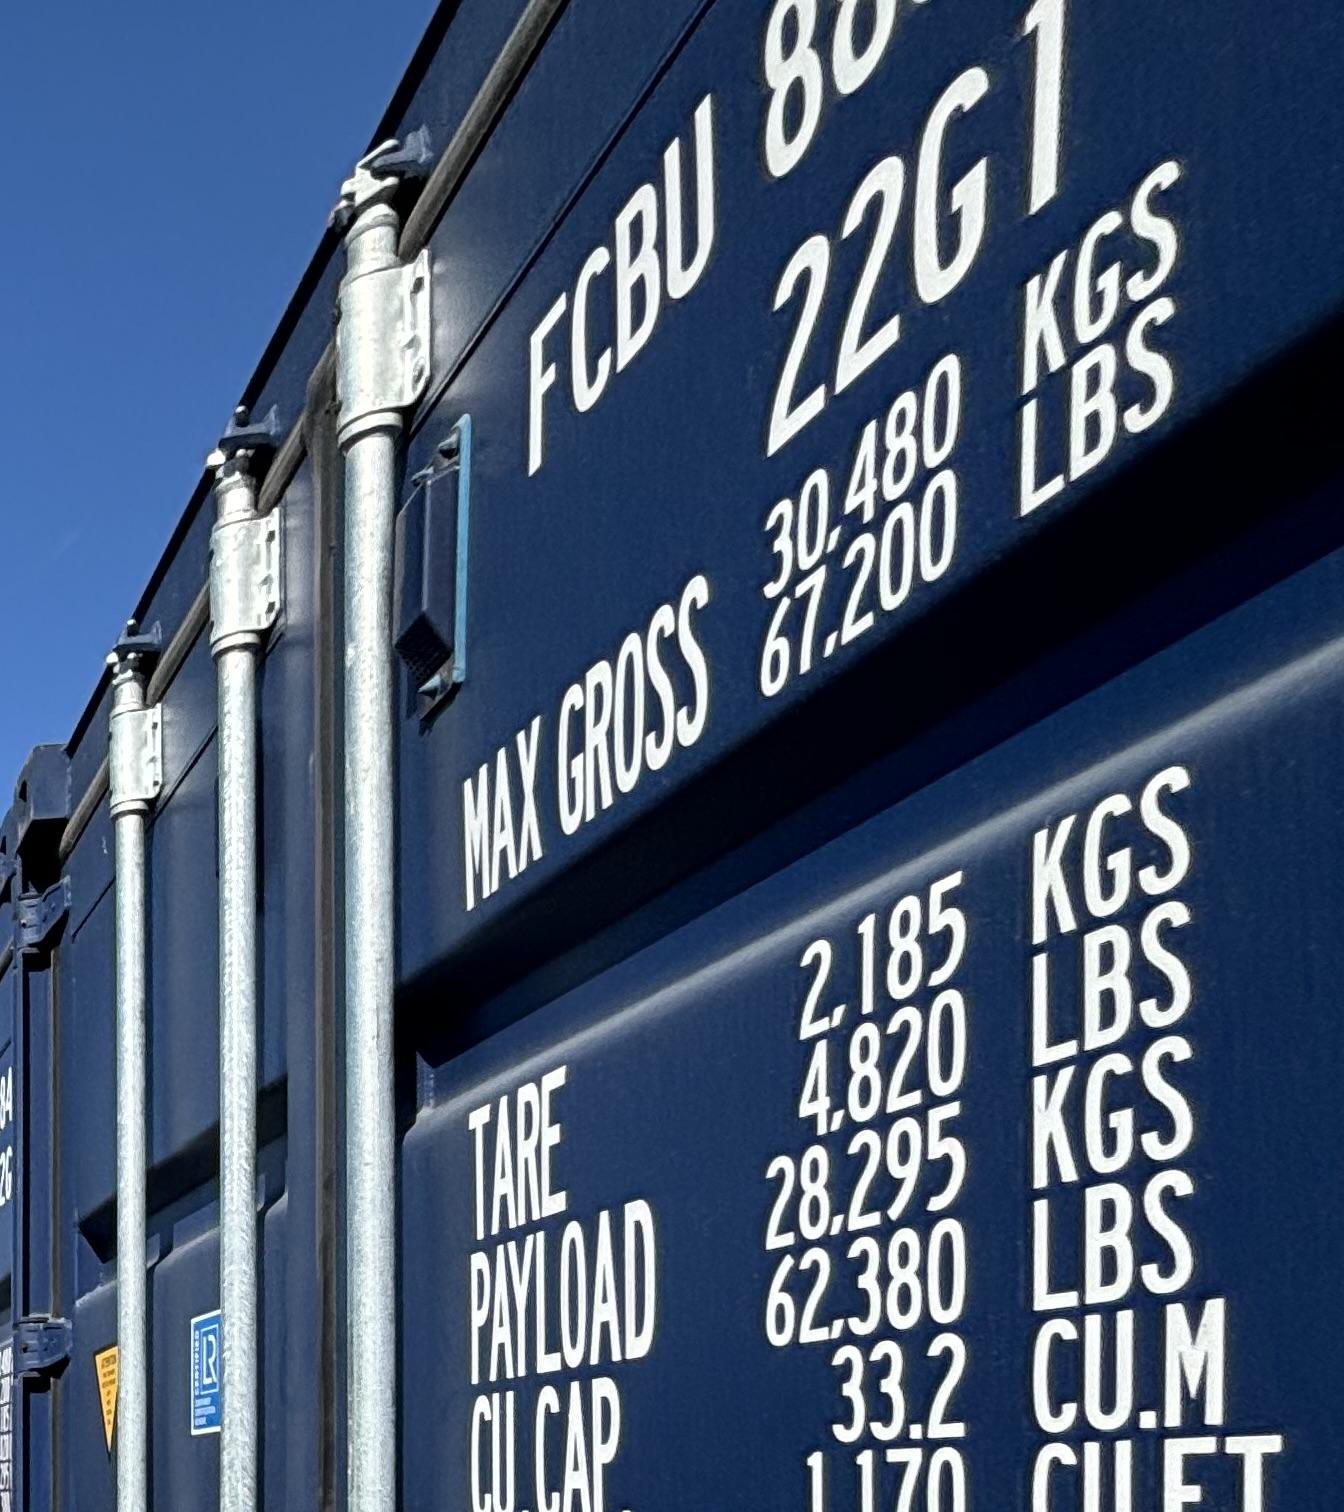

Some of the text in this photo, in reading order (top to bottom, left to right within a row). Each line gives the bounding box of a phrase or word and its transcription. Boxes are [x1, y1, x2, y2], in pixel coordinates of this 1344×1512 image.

[529, 94, 714, 476] FCBU
[767, 0, 1066, 457] 22G1
[1021, 161, 1182, 395] KGS
[1020, 297, 1176, 516] LBS
[464, 575, 709, 911] MAX GROSS
[1032, 766, 1192, 944] KGS
[1032, 901, 1192, 1066] LBS
[469, 1065, 567, 1240] TARE
[1032, 1036, 1193, 1189] KGS
[471, 1200, 655, 1384] PAYLOAD
[1032, 1170, 1193, 1311] LBS
[832, 1298, 1226, 1442] 33.2 CU.M
